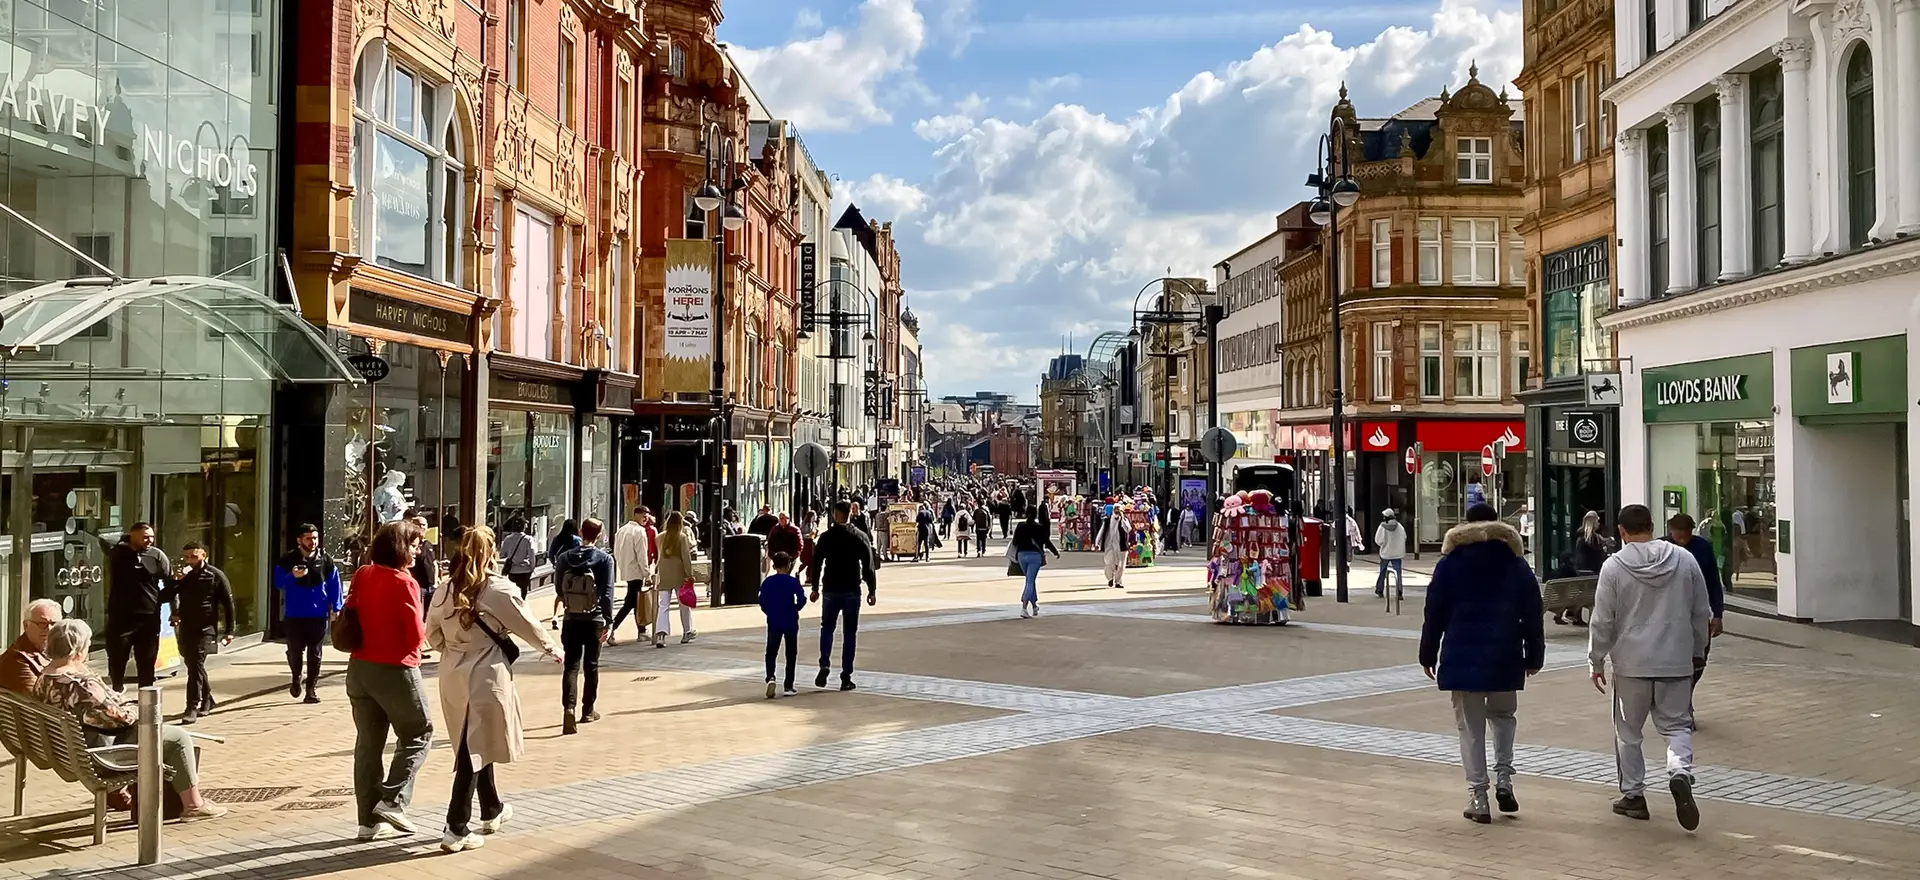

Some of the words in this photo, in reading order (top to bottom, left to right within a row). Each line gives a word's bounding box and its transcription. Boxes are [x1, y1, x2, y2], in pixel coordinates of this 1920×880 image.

[143, 123, 257, 197] NICHOLS
[803, 246, 813, 329] DEBENHAMS
[673, 297, 704, 306] HERE!
[376, 304, 408, 324] HARVEY
[412, 313, 447, 332] NICHOLS
[353, 361, 382, 369] ARVEY
[517, 381, 549, 399] BOODLES
[1656, 378, 1701, 405] LLOYDS
[1703, 374, 1741, 402] BANK
[1555, 420, 1565, 431] THE
[532, 435, 560, 449] BOODLES
